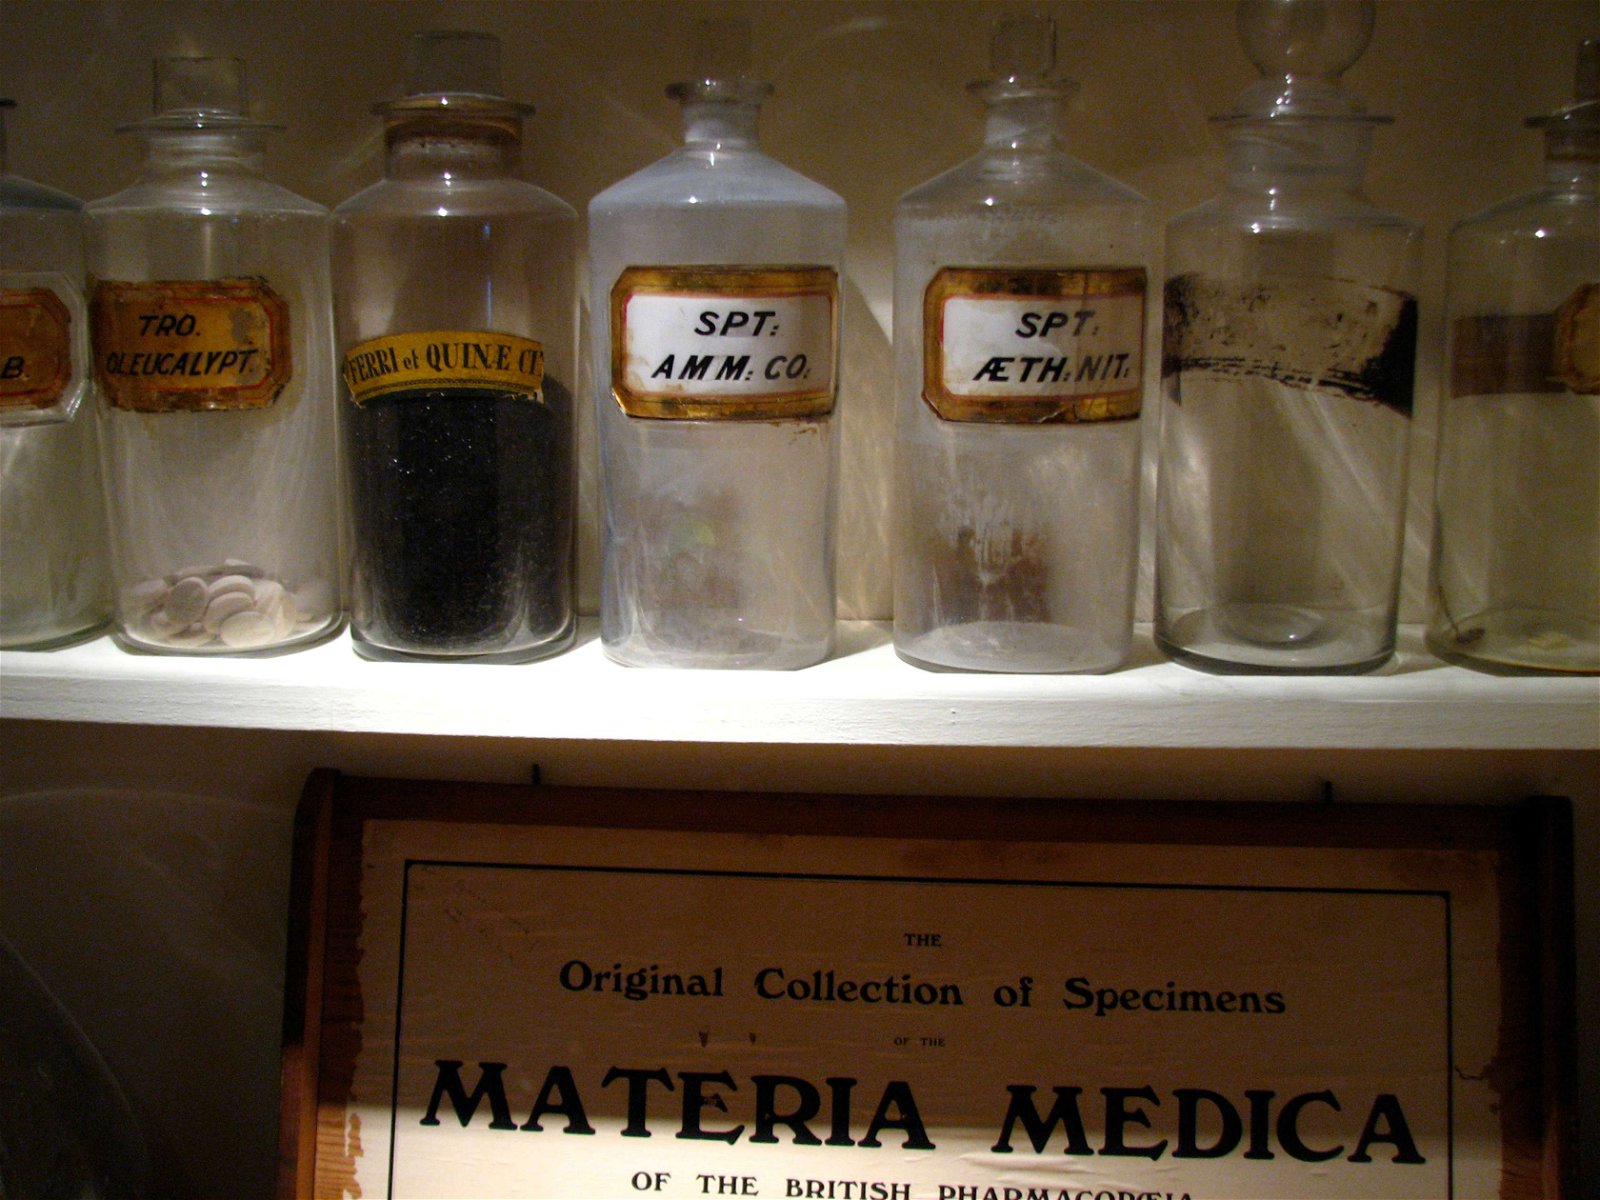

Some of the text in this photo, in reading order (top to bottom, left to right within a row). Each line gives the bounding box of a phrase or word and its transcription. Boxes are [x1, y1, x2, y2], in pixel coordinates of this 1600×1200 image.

[140, 315, 201, 337] TRO.
[904, 933, 942, 946] THE
[560, 961, 1286, 1018] Original Collection of Specimens
[894, 1037, 946, 1046] OF THE
[420, 1061, 1427, 1165] MATERIA MEDICA
[631, 1171, 671, 1191] OF
[696, 1174, 759, 1196] THE
[785, 1178, 911, 1200] BRITISH
